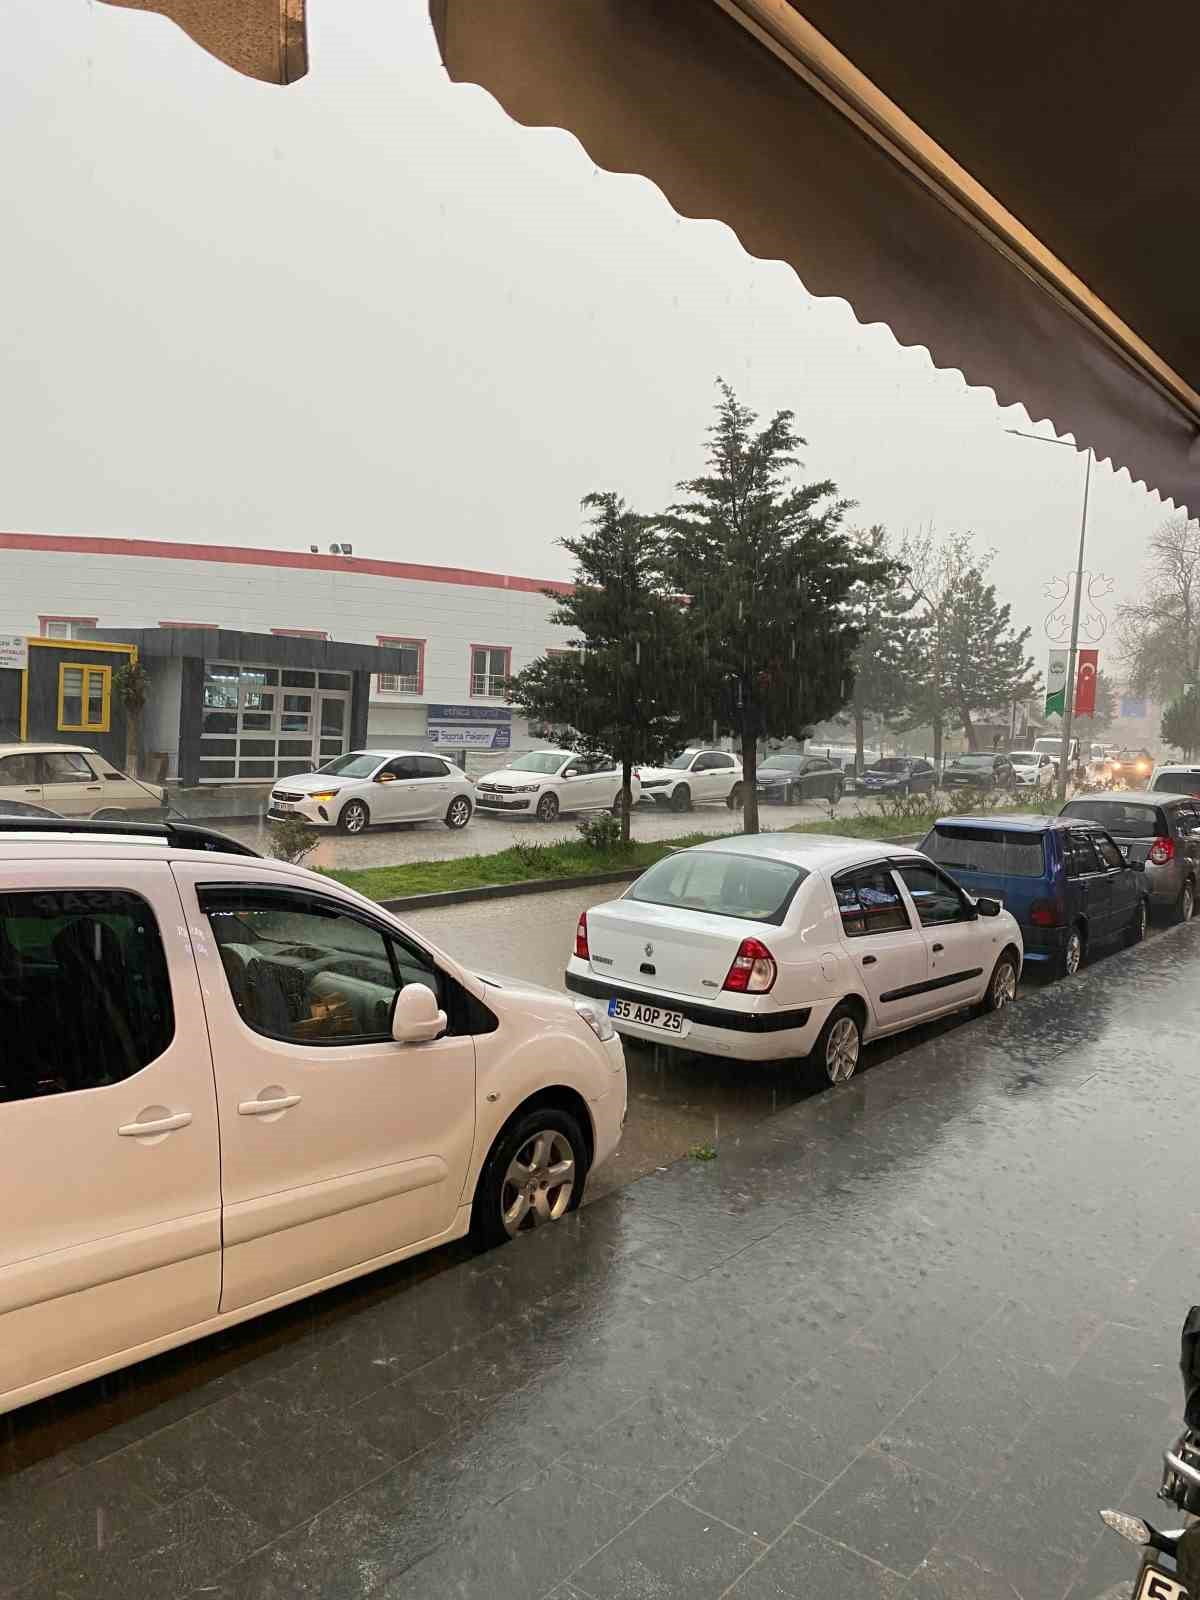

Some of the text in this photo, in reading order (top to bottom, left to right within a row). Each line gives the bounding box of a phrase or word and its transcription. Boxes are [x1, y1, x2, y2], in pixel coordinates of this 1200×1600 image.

[615, 1001, 631, 1018] 55
[634, 1006, 660, 1024] AOP
[663, 1012, 681, 1029] 25
